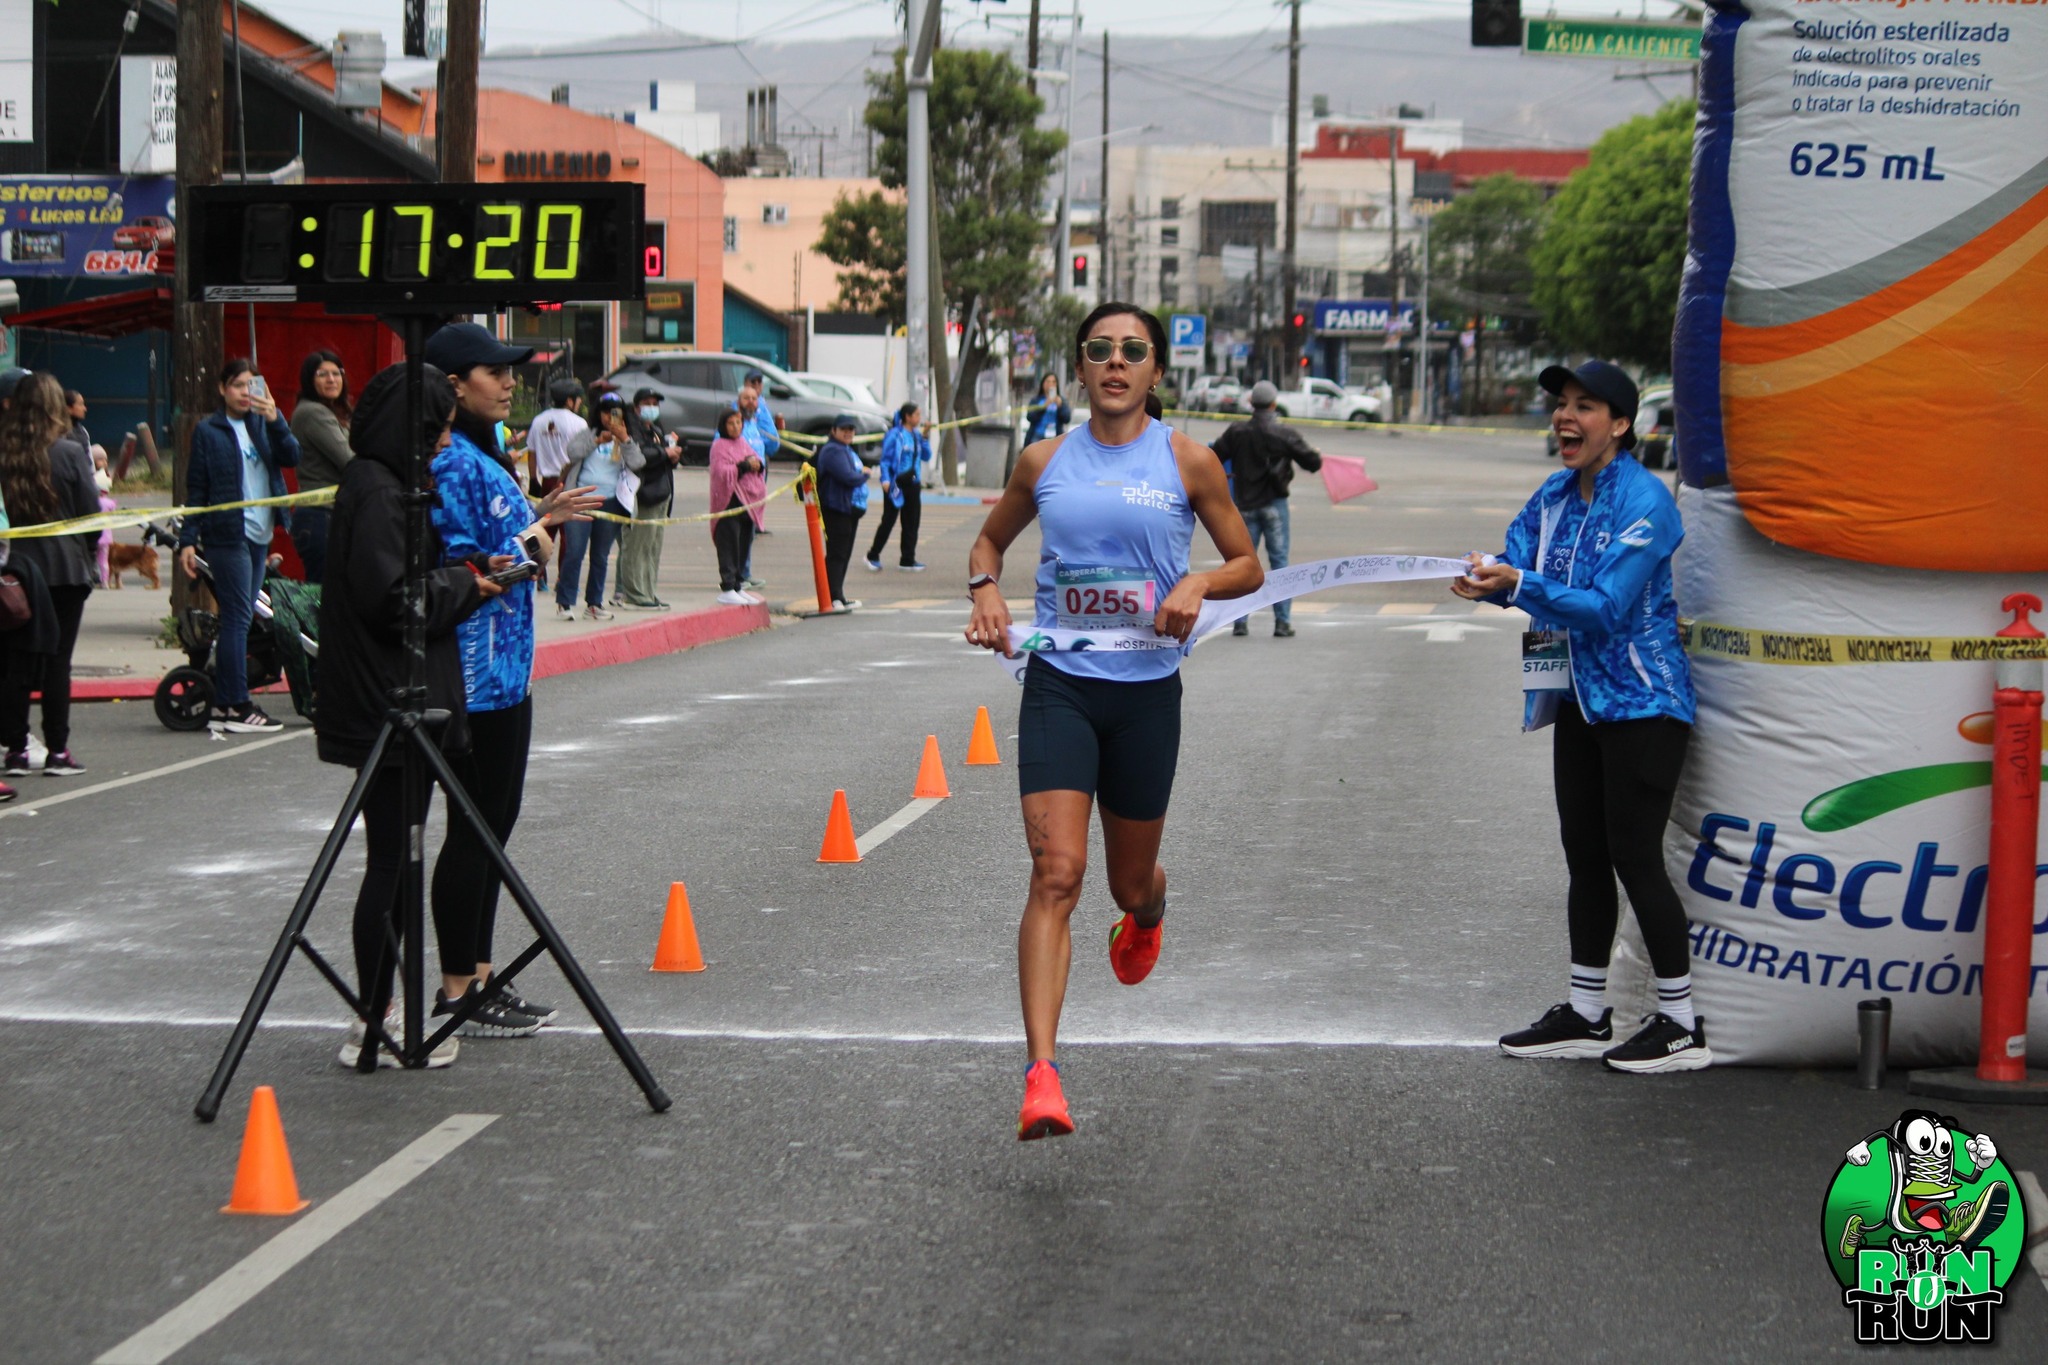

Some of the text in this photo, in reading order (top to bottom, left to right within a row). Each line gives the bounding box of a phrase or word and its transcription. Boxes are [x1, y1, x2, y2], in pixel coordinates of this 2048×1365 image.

[1792, 19, 2010, 42] Solución esterilizada
[1545, 32, 1693, 58] AGUA CALIENTE
[1792, 46, 1981, 66] de electrolitos orales
[1792, 69, 1993, 93] indicada para prevenir
[0, 100, 16, 119] E
[1792, 95, 2021, 117] o tratar la deshidratación
[504, 150, 612, 178] MILENIO
[1790, 141, 1945, 181] 625 mL
[0, 183, 109, 202] stereos
[30, 206, 86, 224] Luces
[1175, 318, 1194, 342] P
[1127, 496, 1170, 511] MEXICO
[1065, 587, 1140, 615] 0255
[1114, 640, 1167, 650] HOSPITA
[465, 640, 477, 703] HOSPITAL
[1523, 661, 1569, 672] STAFF
[1648, 639, 1681, 707] FLORENCE
[1667, 1034, 1694, 1053] HOKA
